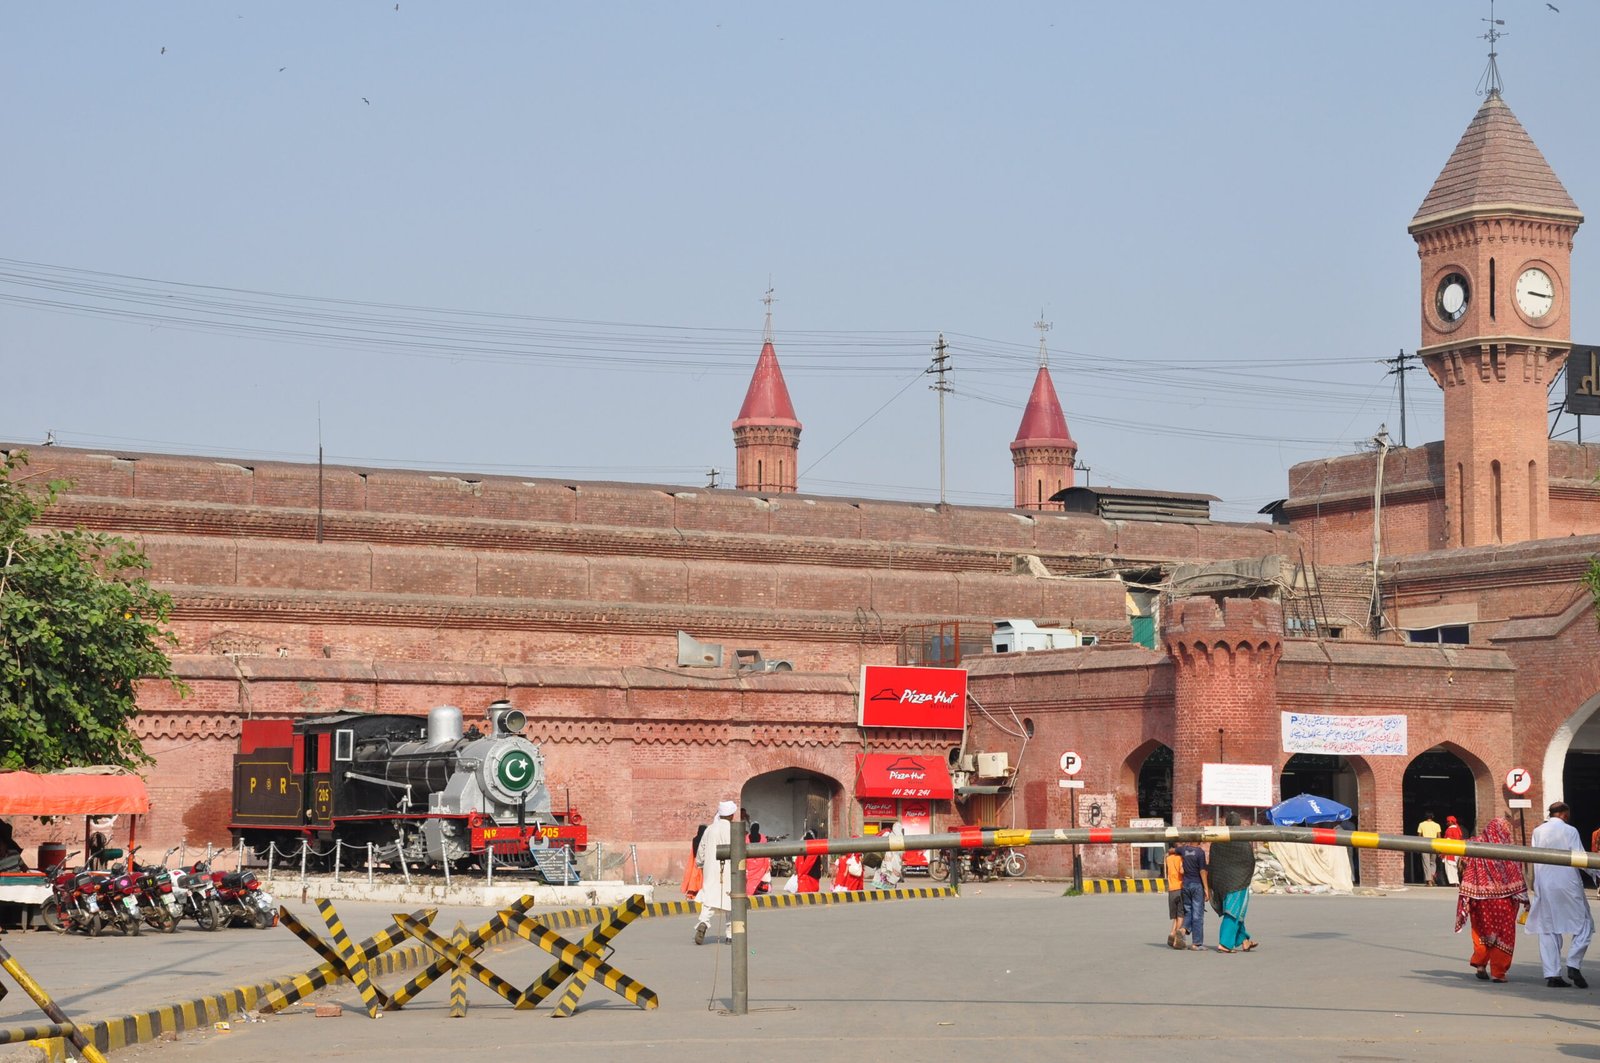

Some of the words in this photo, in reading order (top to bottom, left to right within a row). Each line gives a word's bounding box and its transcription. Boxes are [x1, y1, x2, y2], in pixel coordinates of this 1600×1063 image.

[900, 689, 932, 704] Pizza
[934, 690, 959, 704] Hut
[1066, 756, 1075, 769] P
[889, 771, 910, 780] Pizza
[910, 771, 926, 780] Hut
[1514, 773, 1522, 786] P
[250, 777, 257, 794] P
[280, 777, 286, 794] R
[903, 788, 915, 796] 241
[917, 788, 931, 796] 241
[318, 788, 329, 802] 205
[1091, 805, 1101, 823] P
[541, 827, 559, 838] 205
